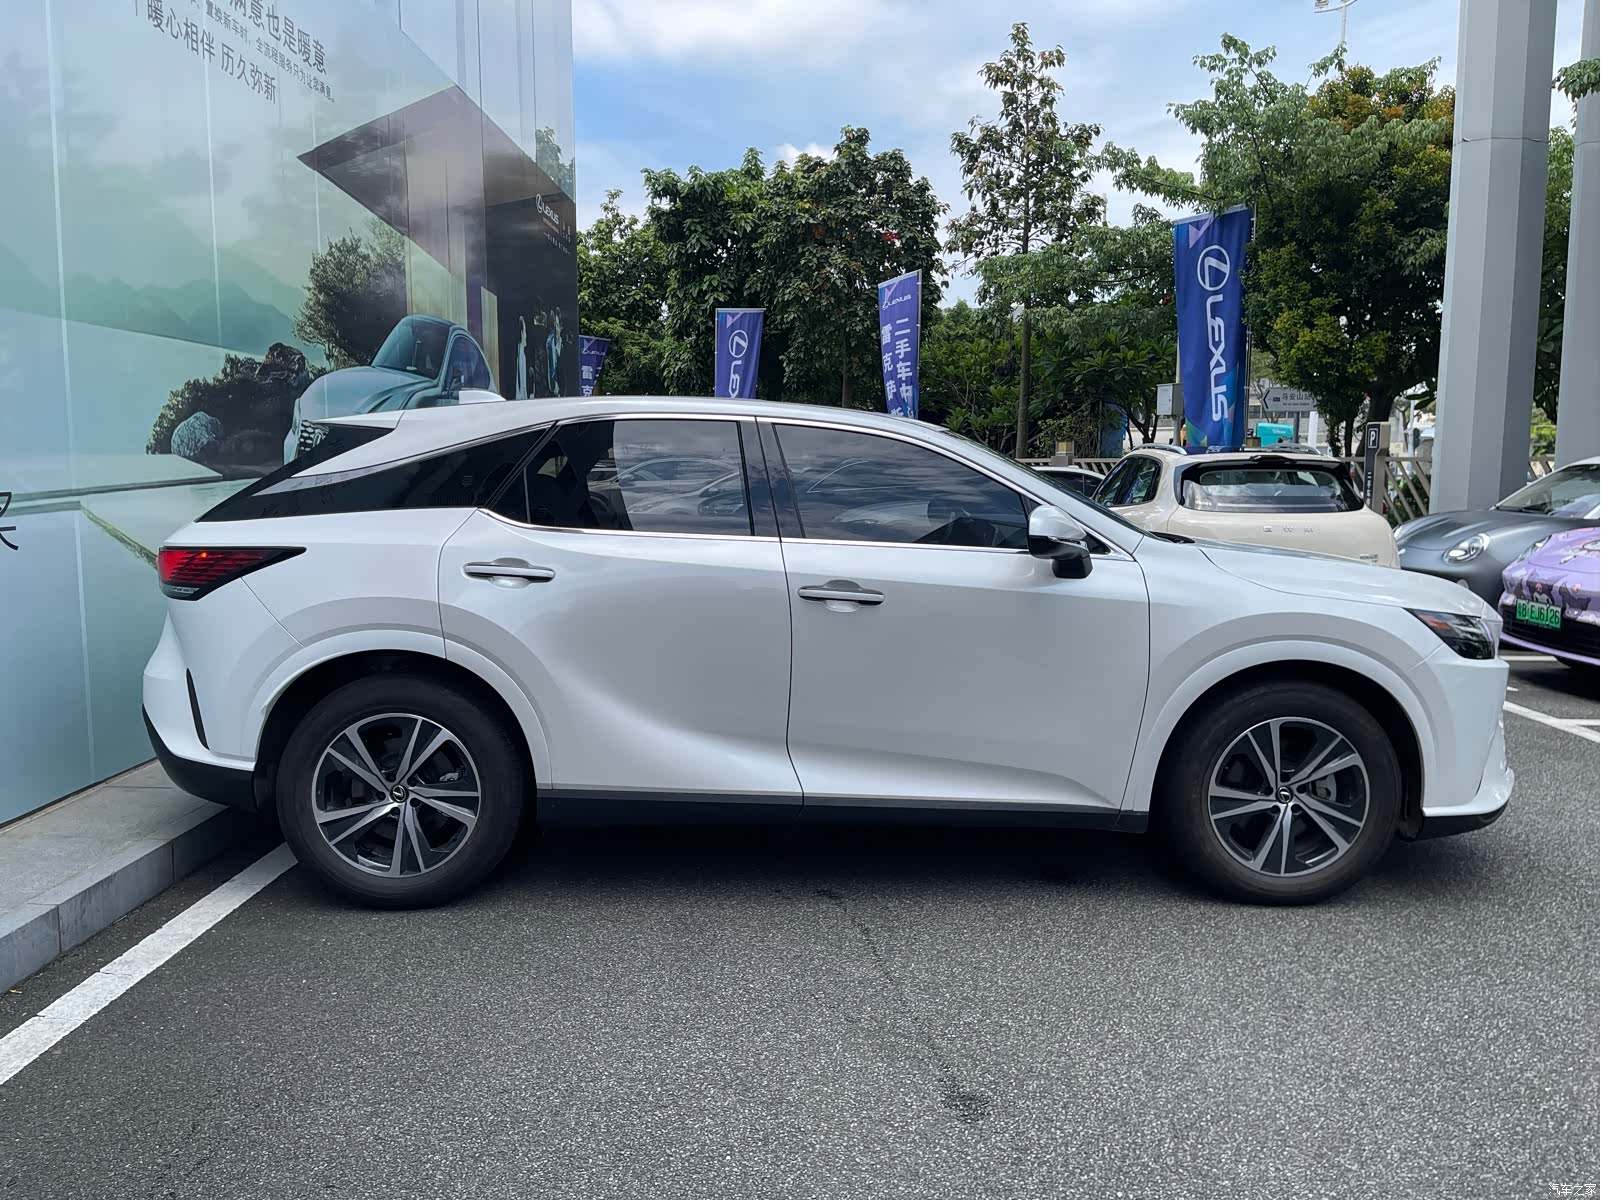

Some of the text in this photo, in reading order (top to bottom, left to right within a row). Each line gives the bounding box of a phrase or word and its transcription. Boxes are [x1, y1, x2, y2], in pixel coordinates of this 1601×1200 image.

[221, 42, 276, 104] 历久弥新
[1206, 293, 1229, 423] LEXUS
[1369, 430, 1376, 447] P
